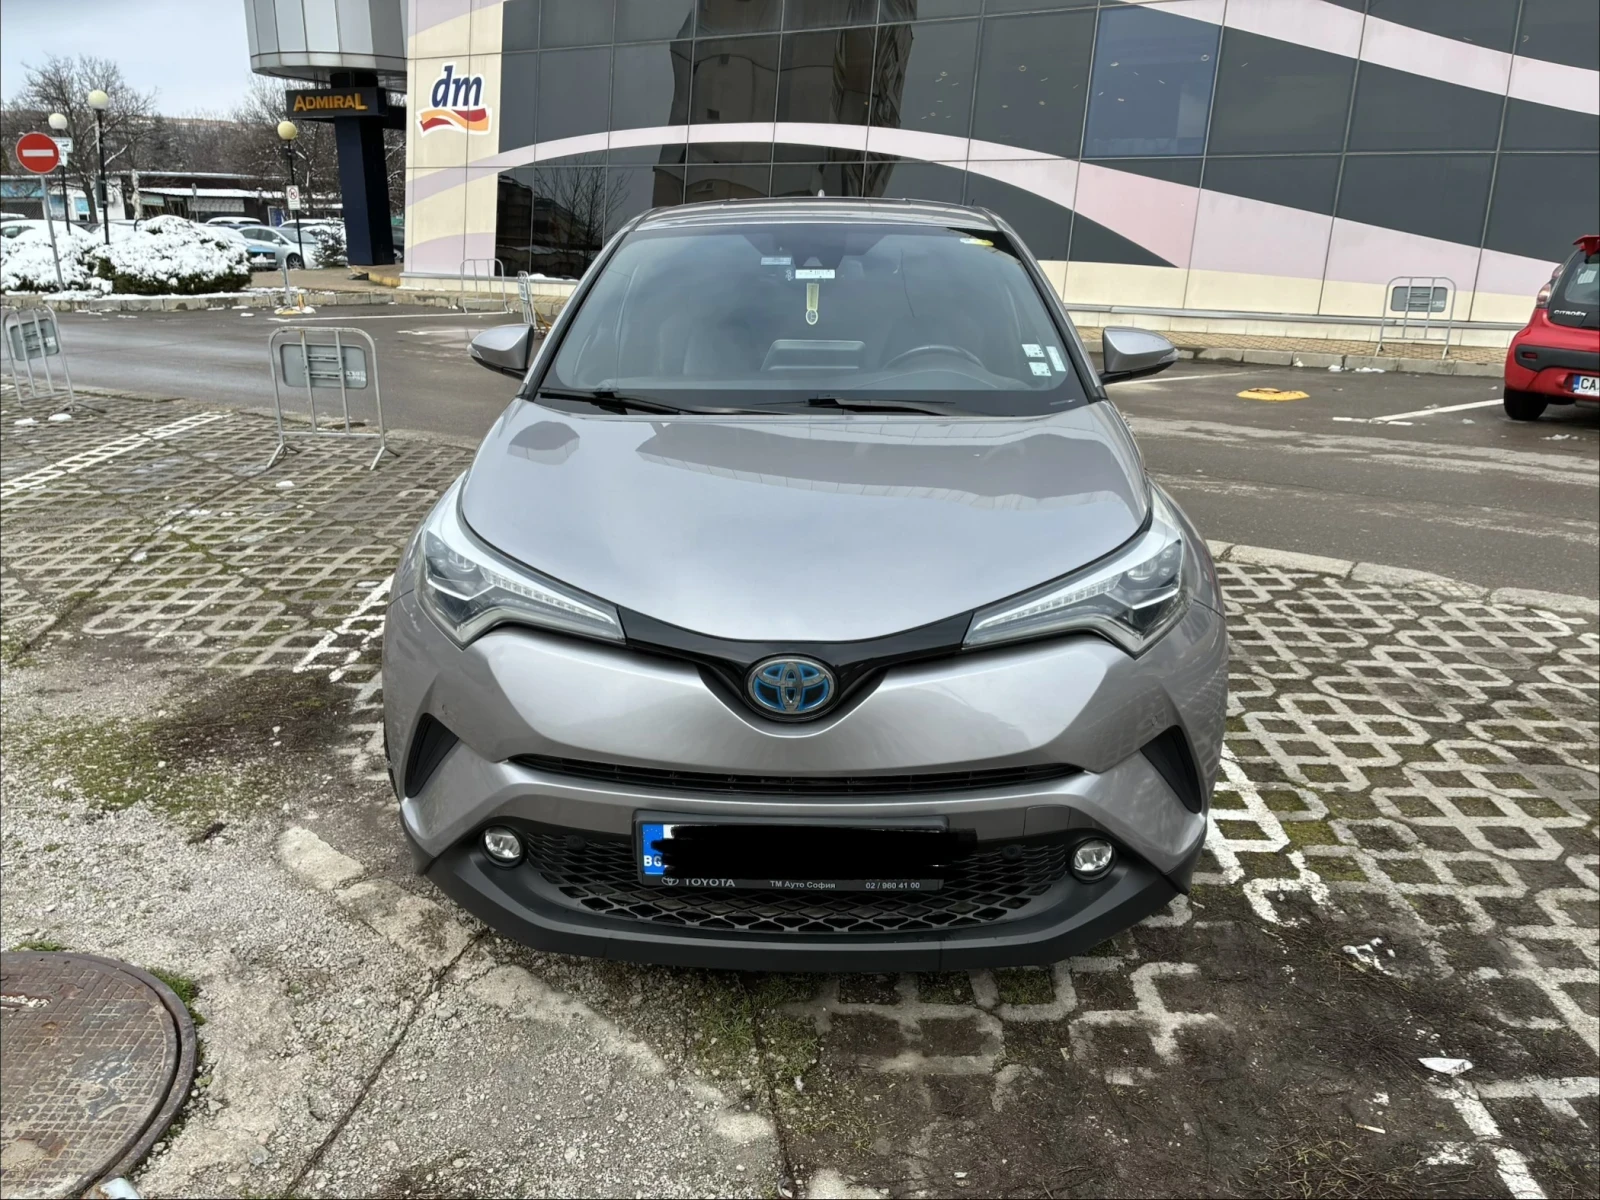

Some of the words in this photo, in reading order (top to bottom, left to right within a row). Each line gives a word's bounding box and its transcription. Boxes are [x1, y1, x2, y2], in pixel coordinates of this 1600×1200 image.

[431, 65, 482, 108] dm
[293, 93, 368, 112] ADMIRAL
[643, 855, 662, 867] BG
[684, 878, 736, 887] TOYOTA
[784, 880, 804, 889] Ауто
[806, 881, 836, 889] София
